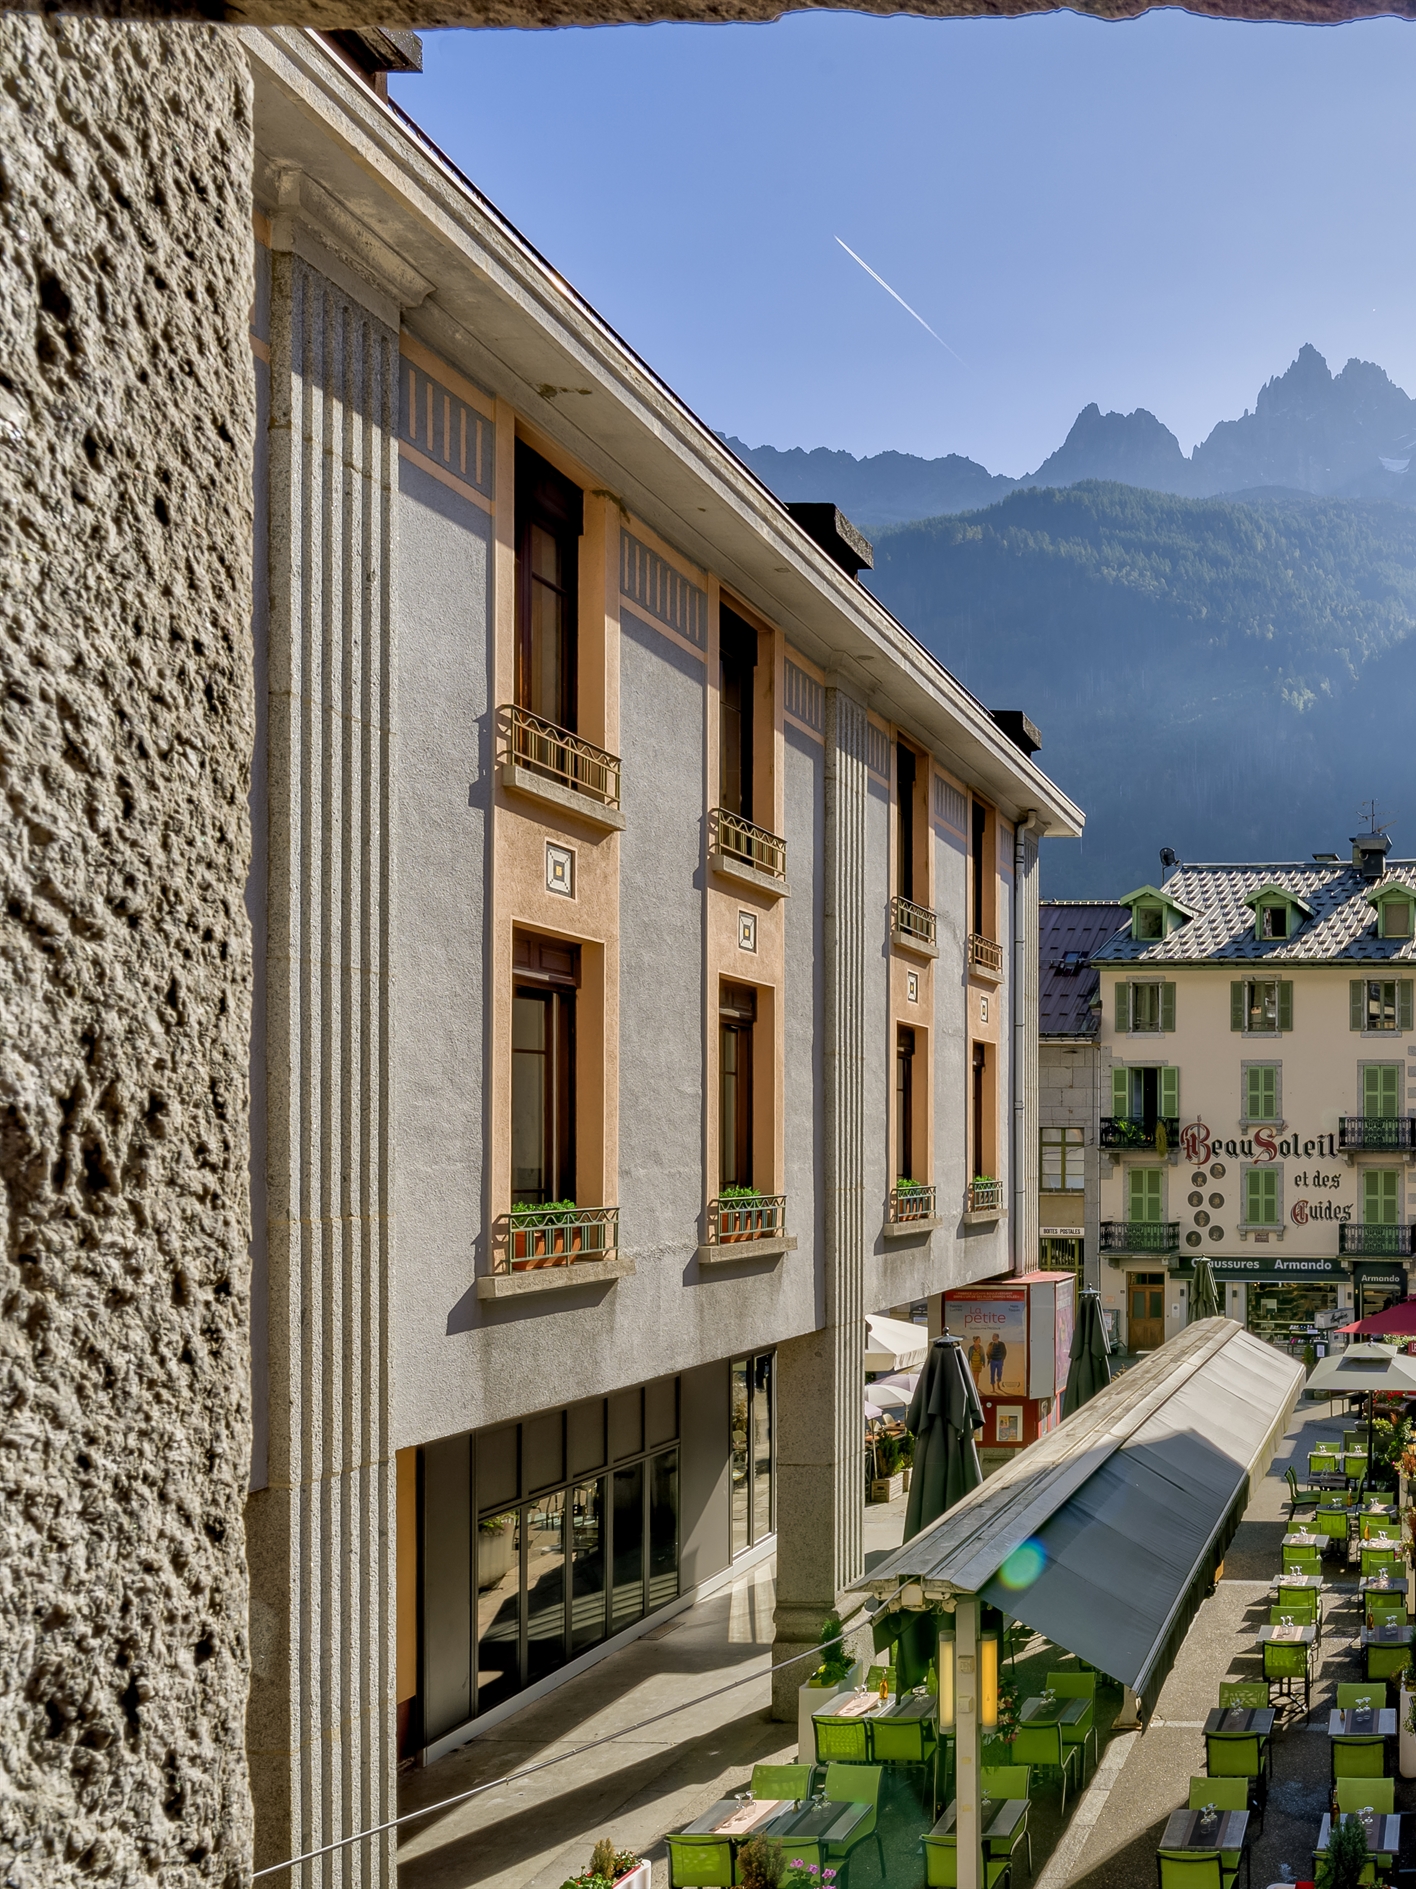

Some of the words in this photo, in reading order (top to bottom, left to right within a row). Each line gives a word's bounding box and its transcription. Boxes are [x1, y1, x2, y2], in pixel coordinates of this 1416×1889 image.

[1253, 1126, 1339, 1165] Soleil
[1294, 1171, 1309, 1187] et
[1312, 1170, 1342, 1189] des
[1290, 1199, 1354, 1226] Guides
[1191, 1257, 1260, 1269] Caussures
[1274, 1259, 1332, 1270] Armando
[1361, 1274, 1400, 1282] Armando
[969, 1306, 982, 1315] La
[964, 1312, 1006, 1328] petite
